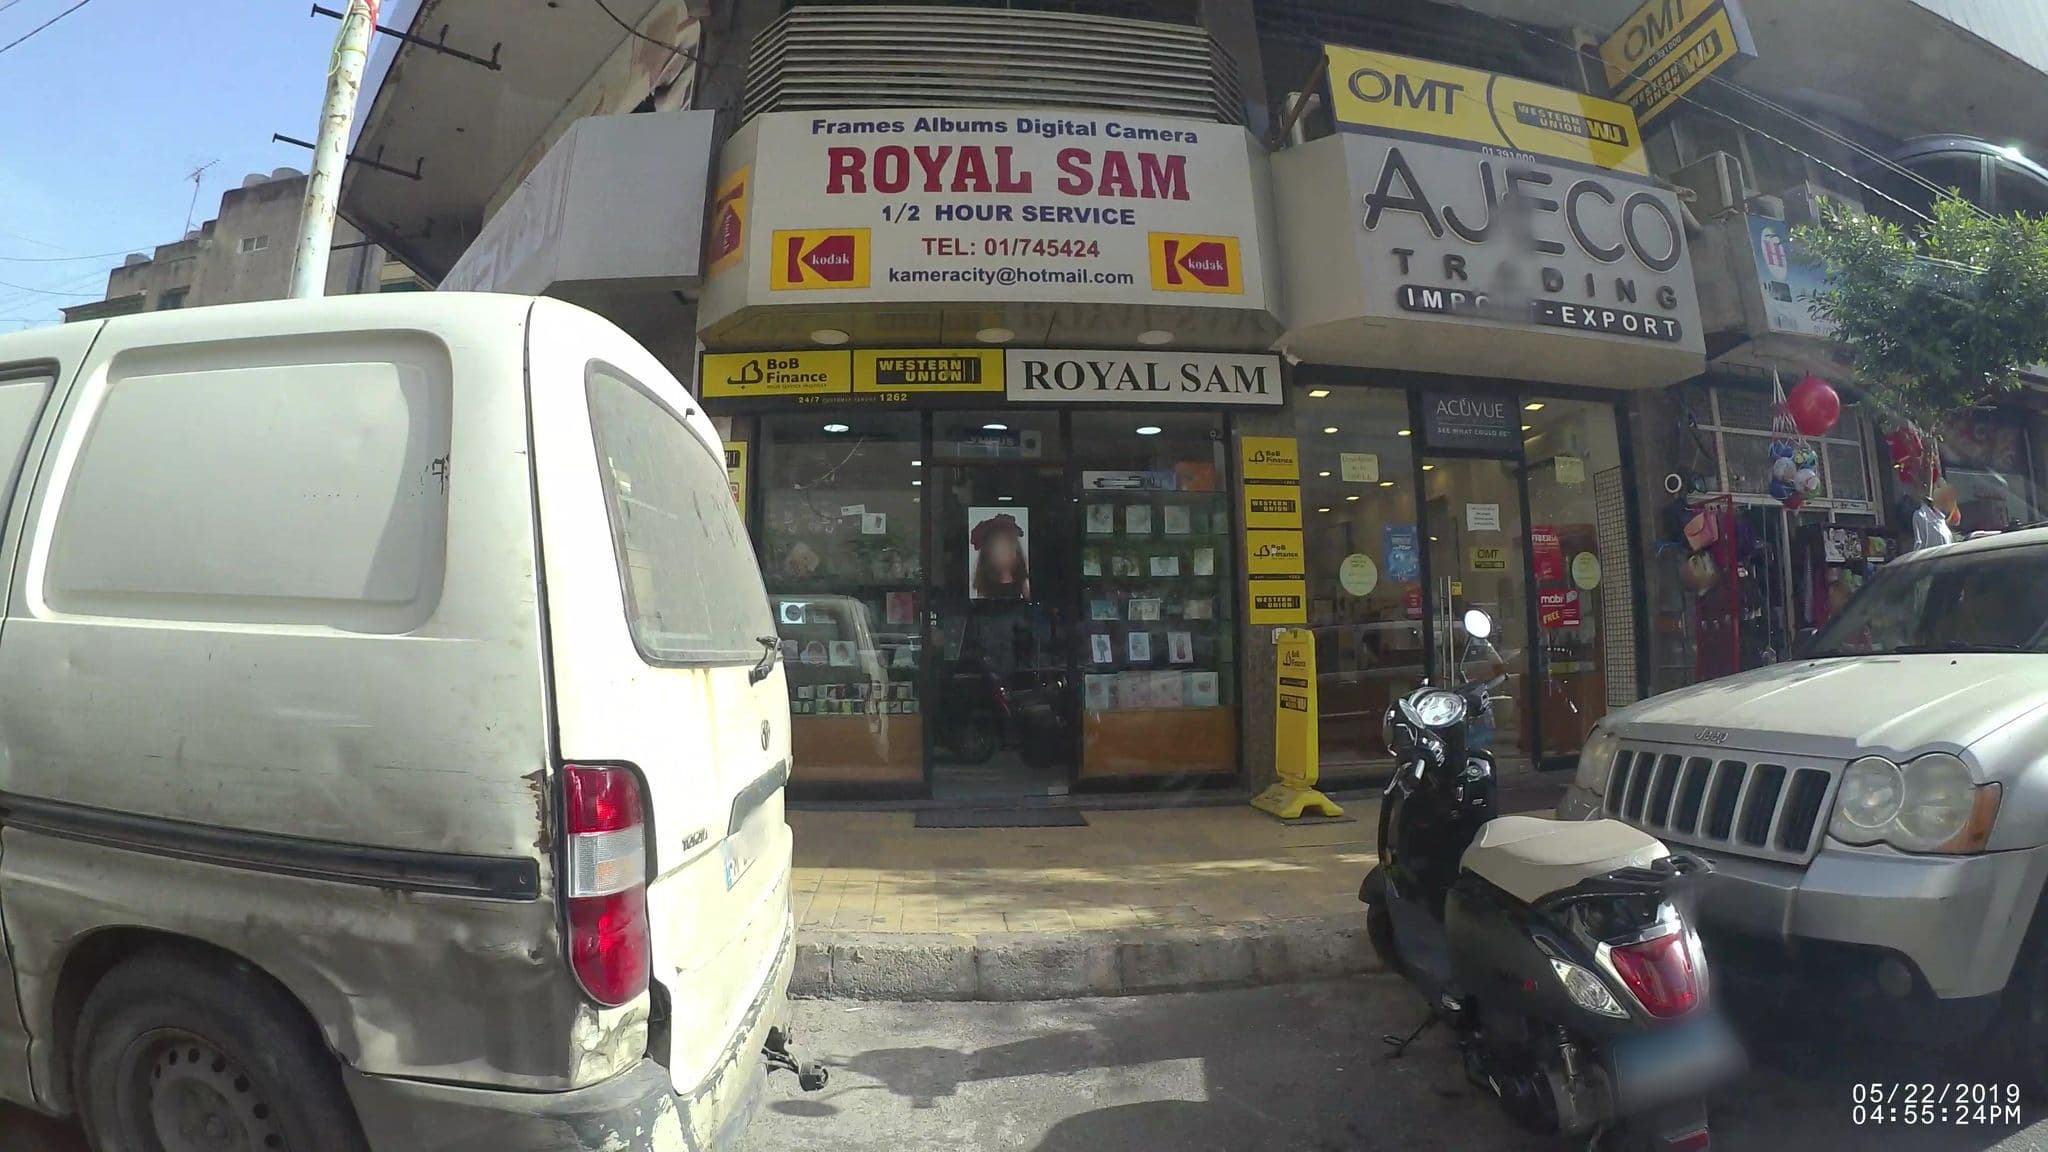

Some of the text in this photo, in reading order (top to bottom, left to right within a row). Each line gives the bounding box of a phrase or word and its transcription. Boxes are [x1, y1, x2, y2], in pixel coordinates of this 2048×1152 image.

[1348, 67, 1464, 115] OMT
[812, 117, 1198, 144] Frames Albums Digital Camera
[1518, 105, 1621, 143] WESTERN WU
[1539, 119, 1582, 134] UNION
[826, 145, 1190, 201] ROYAL SAM
[881, 202, 1136, 225] 1/2 HOUR SERVICE
[1364, 147, 1682, 273] AJECO
[921, 237, 1100, 258] TEL: 01/745424
[811, 253, 850, 265] kodak
[1188, 257, 1224, 271] kodak
[889, 266, 1134, 286] kameracity@hotmail.com
[1392, 247, 1678, 310] TRDING
[767, 357, 800, 370] BoB
[879, 359, 962, 371] WESTERN
[766, 371, 828, 384] Finance
[905, 370, 962, 382] UNION
[1022, 360, 1269, 395] ROYAL SAM
[879, 393, 908, 402] 1262
[1695, 727, 1729, 744] Jeep
